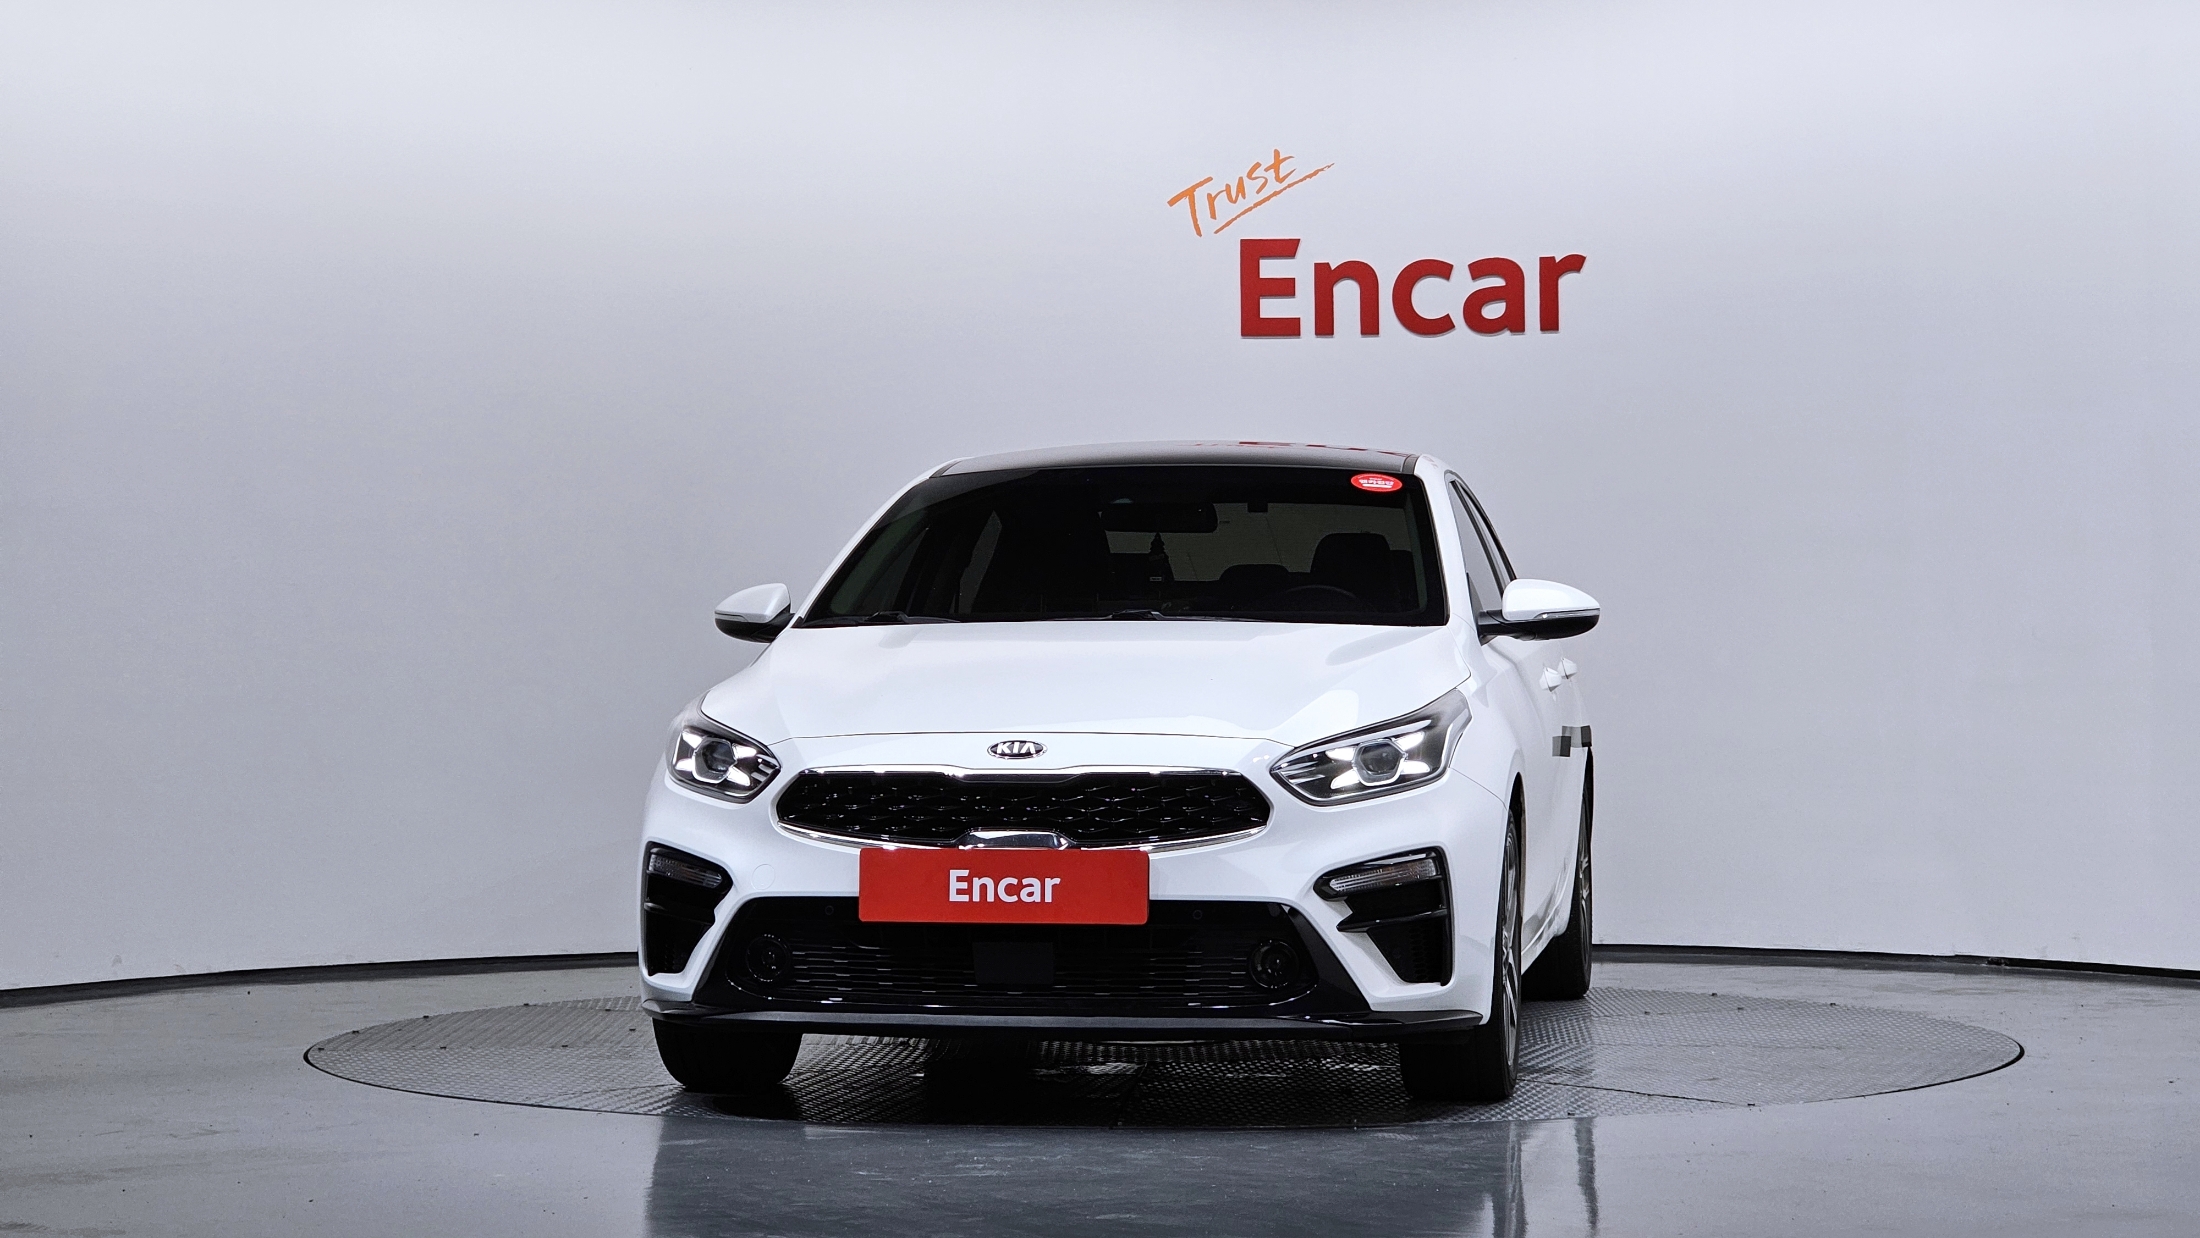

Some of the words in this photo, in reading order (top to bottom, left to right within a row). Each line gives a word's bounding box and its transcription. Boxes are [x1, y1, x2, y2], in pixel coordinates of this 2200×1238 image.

[1167, 148, 1298, 238] Trust
[1239, 238, 1587, 338] Encar
[996, 741, 1037, 754] KIA
[949, 869, 1061, 903] Encar
